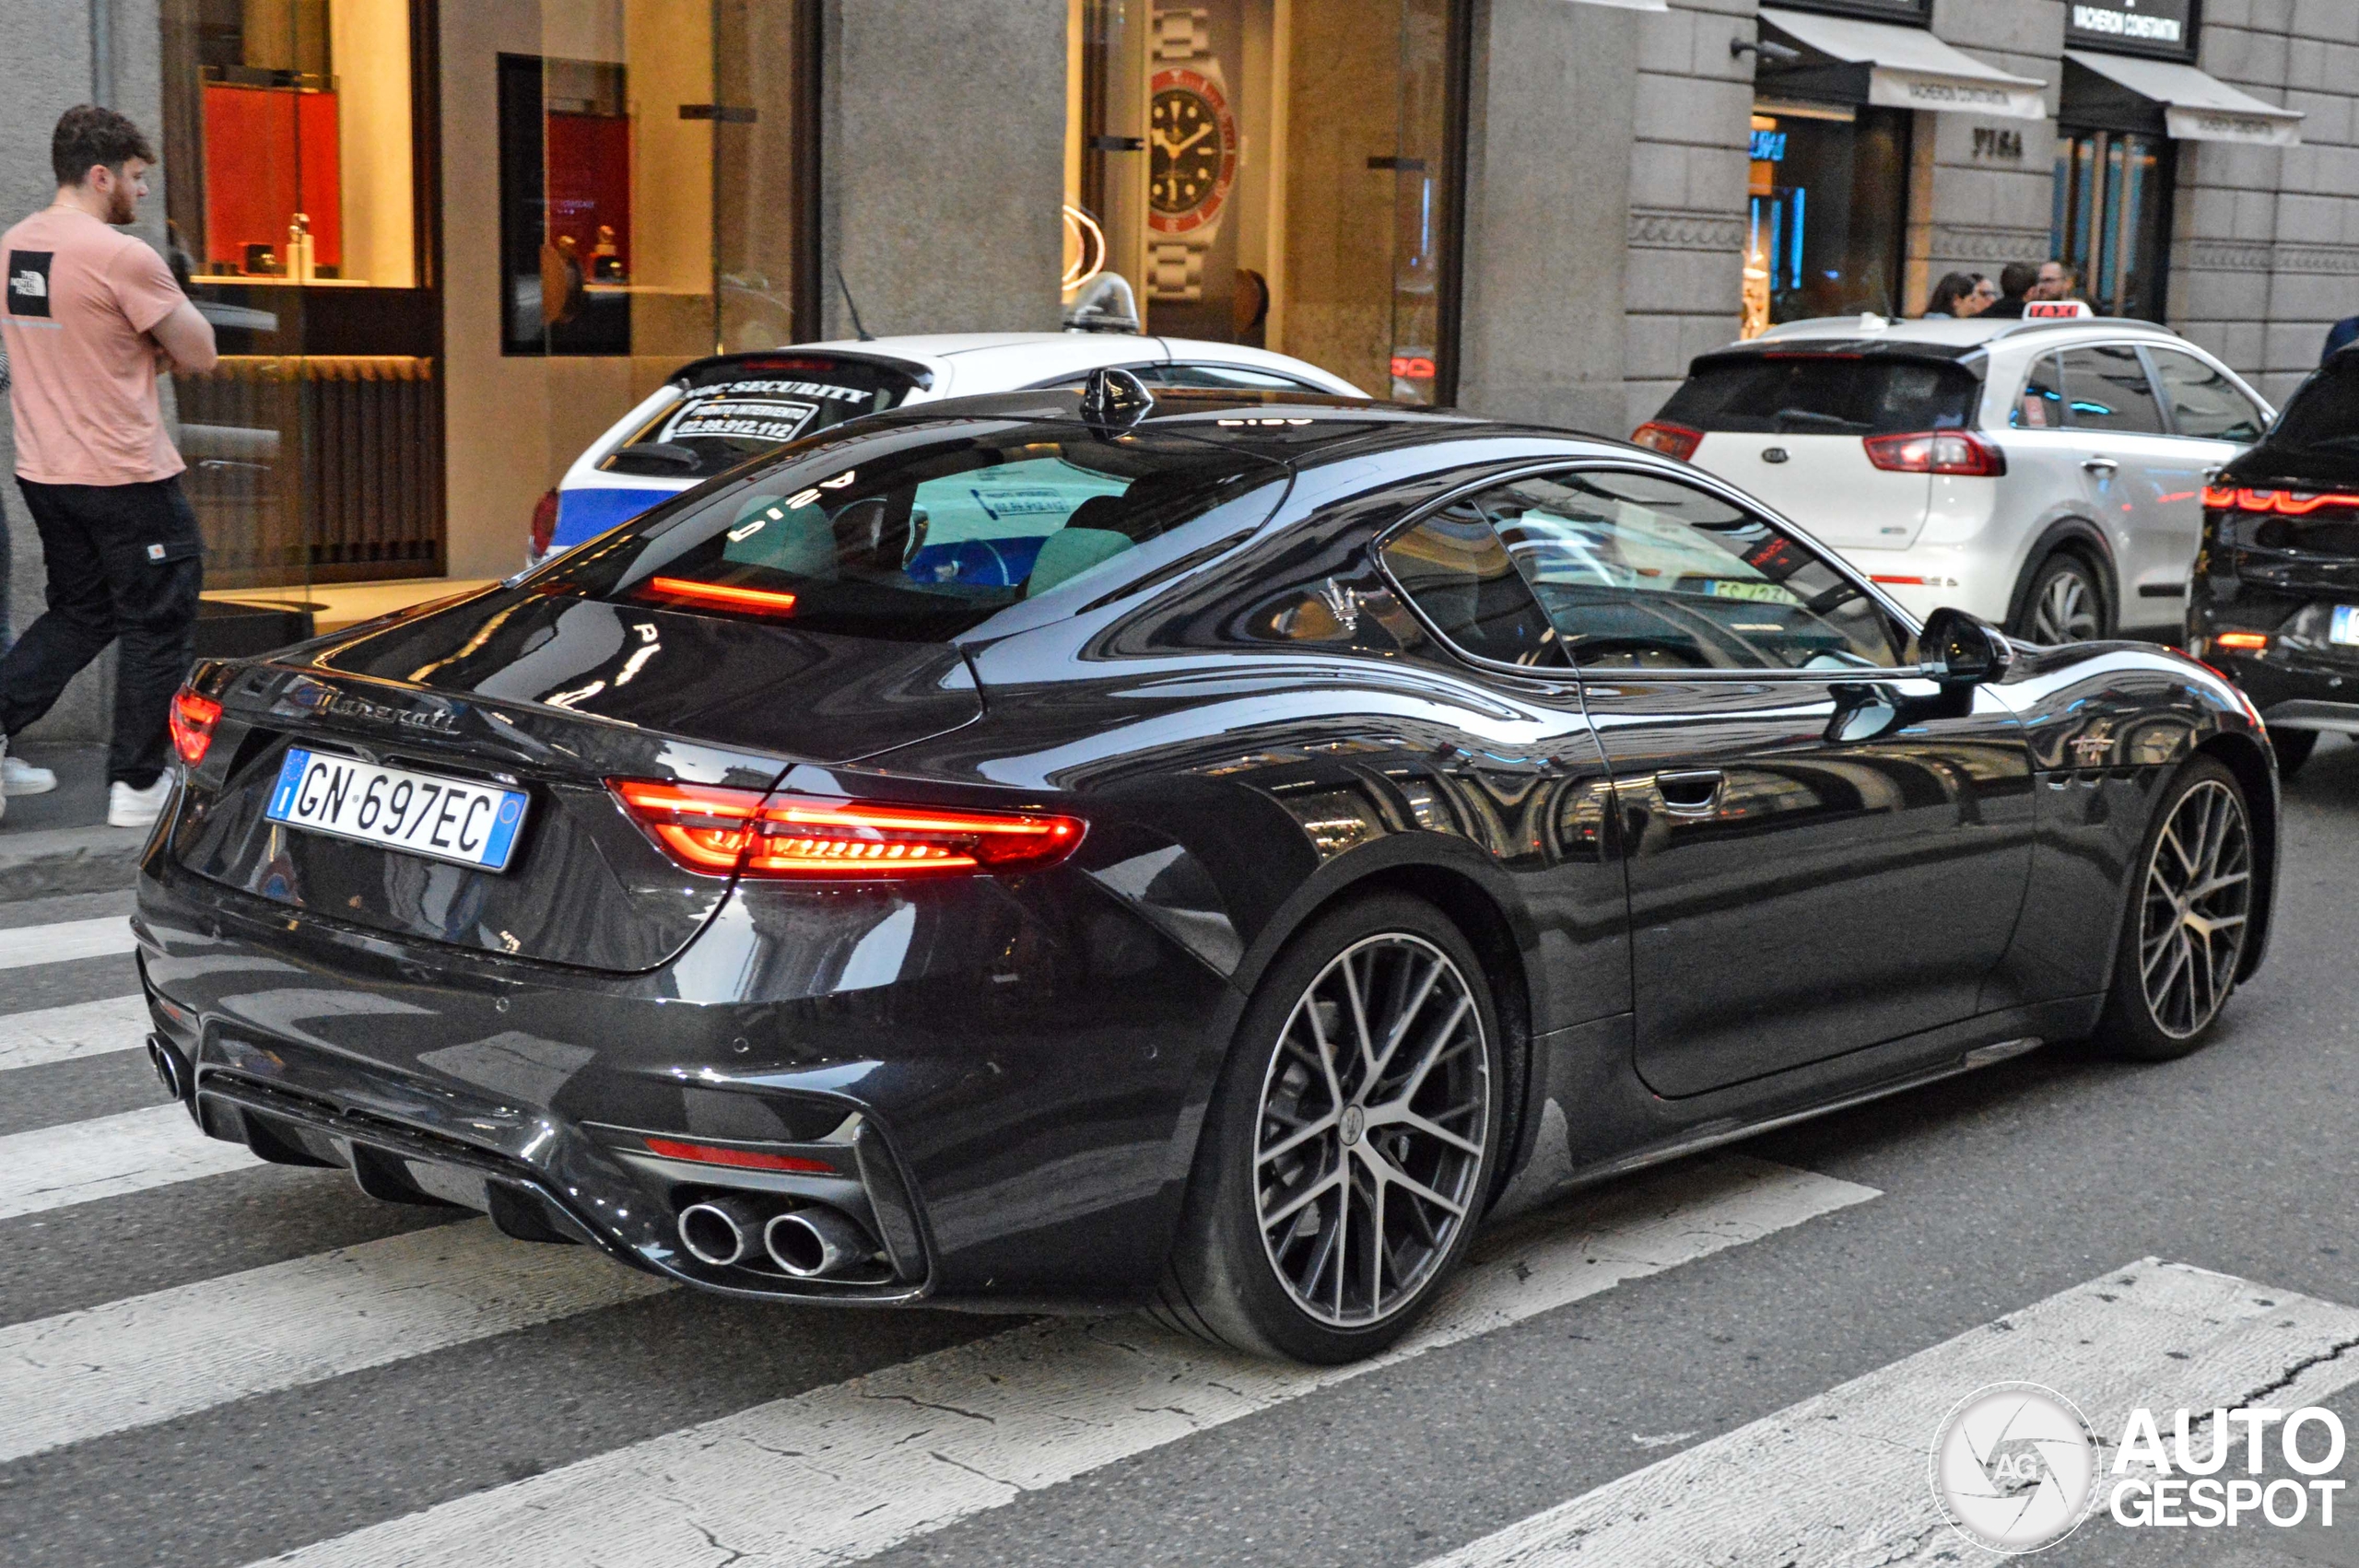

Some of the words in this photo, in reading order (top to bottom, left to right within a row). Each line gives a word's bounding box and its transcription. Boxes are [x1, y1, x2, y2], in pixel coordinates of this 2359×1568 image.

[2030, 304, 2080, 318] TAXI
[727, 380, 874, 404] SECURITY
[316, 690, 461, 735] Maserati
